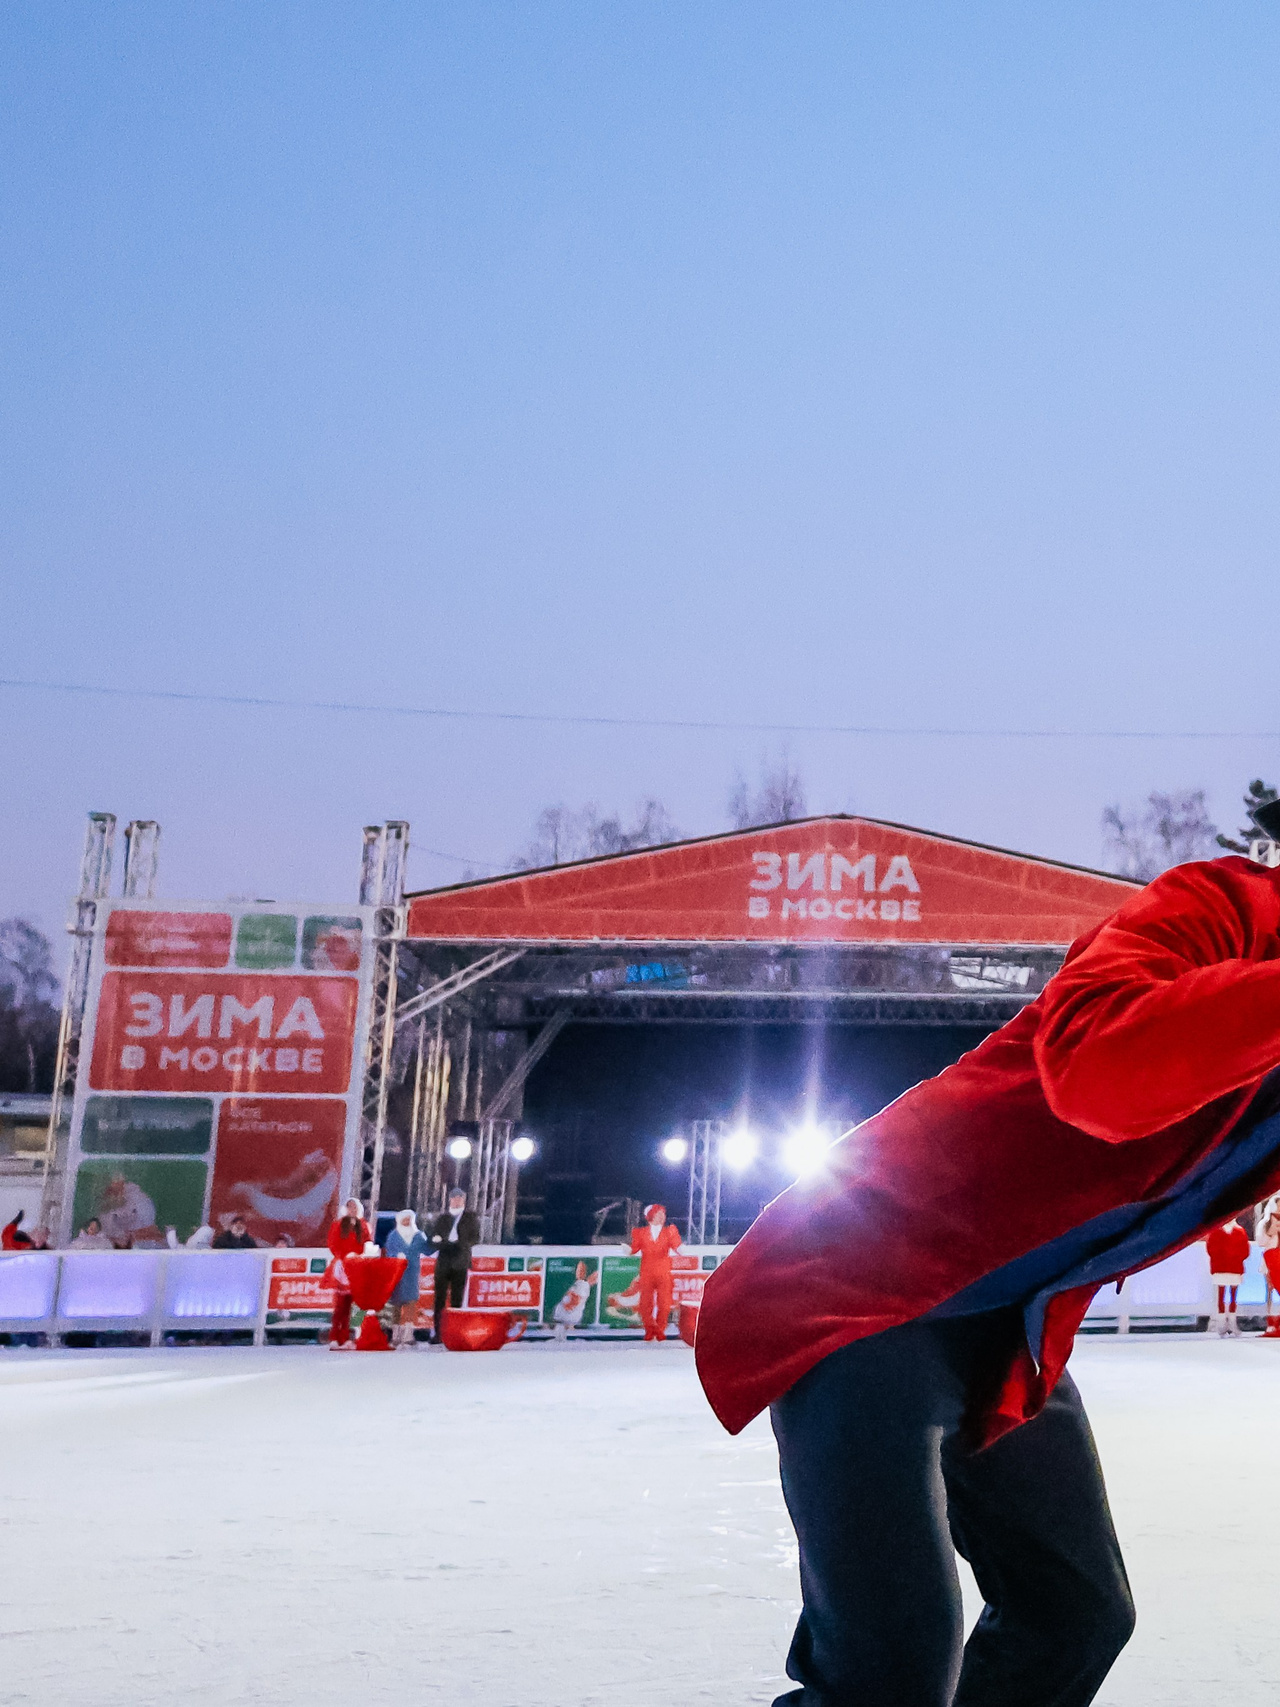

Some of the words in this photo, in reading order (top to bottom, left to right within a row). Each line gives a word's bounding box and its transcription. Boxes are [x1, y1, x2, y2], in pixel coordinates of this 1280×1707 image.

[750, 851, 921, 893] ЗИМА
[748, 896, 770, 918] В
[781, 897, 921, 921] МОСКВЕ
[125, 991, 325, 1040] ЗИМА
[120, 1044, 146, 1071] В
[159, 1045, 325, 1073] МОСКВЕ
